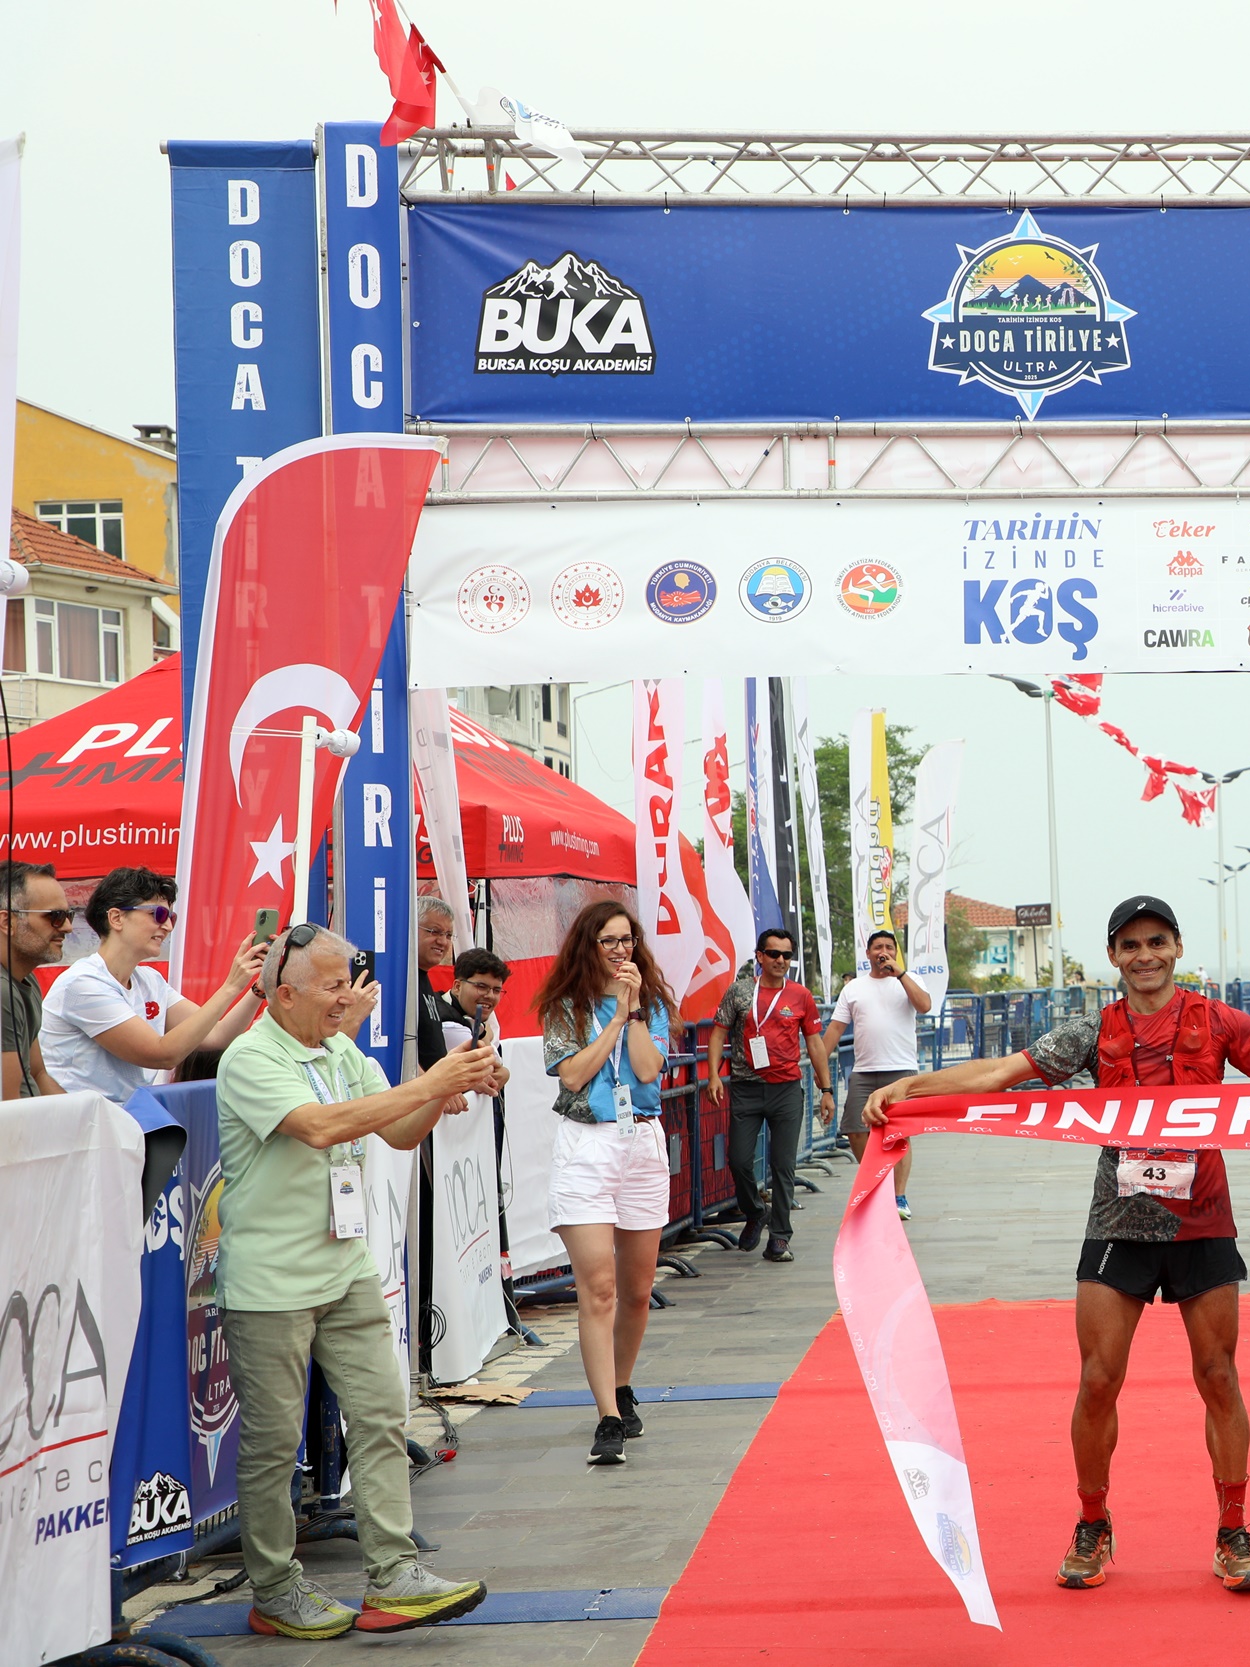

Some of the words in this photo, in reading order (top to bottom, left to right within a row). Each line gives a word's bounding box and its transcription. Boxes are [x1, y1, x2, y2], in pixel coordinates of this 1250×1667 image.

[227, 180, 267, 412] DOCA
[479, 298, 652, 353] BUKA
[959, 329, 1015, 354] DOCA
[1024, 326, 1103, 353] TİRİLYE
[477, 357, 525, 373] BURSA
[528, 357, 570, 376] KOŞU
[573, 355, 653, 373] AKADEMİSİ
[1003, 360, 1058, 374] ULTRA
[963, 512, 1102, 541] TARİHİN
[963, 546, 1104, 570] İZİNDE
[650, 564, 673, 586] TÜRKİYE
[674, 562, 713, 584] CUMHURİYETİ
[1168, 566, 1203, 577] Kappa
[650, 602, 673, 622] MUDANYA
[963, 577, 1098, 661] KOŞ
[1151, 604, 1205, 613] hicreative
[1143, 629, 1214, 648] CAWRA
[503, 815, 525, 843] PLUS
[498, 843, 525, 864] TIMING
[1143, 1167, 1166, 1181] 43
[1098, 1242, 1114, 1275] SALOMON
[128, 1491, 192, 1535] BUKA
[144, 1528, 160, 1541] KOŞU
[161, 1521, 192, 1537] AKADEMİSİ
